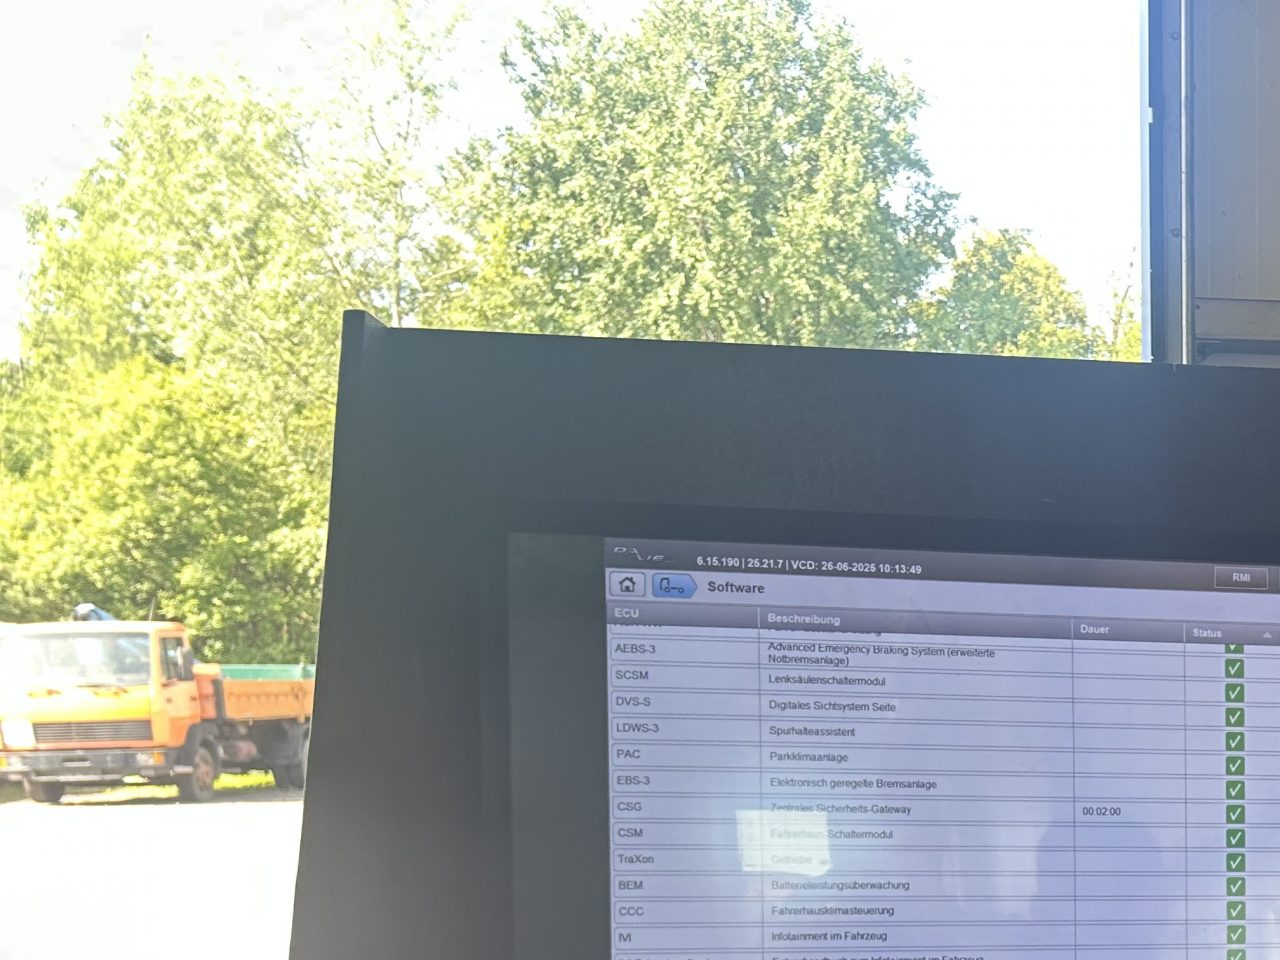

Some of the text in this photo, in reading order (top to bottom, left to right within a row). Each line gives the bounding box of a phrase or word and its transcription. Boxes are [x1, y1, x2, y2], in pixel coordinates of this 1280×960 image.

[697, 556, 740, 568] 6.15.190
[747, 558, 783, 569] 25.21.7
[791, 560, 818, 571] VCD:
[821, 561, 876, 573] 26-06-2025
[878, 563, 922, 575] 10:13:49
[1231, 572, 1251, 582] RMI
[707, 580, 765, 595] Software
[614, 608, 639, 618] ECU
[767, 613, 841, 627] Beschreibung
[1080, 624, 1109, 635] Dauer
[1192, 628, 1222, 639] Status
[614, 643, 656, 655] AEBS-3
[767, 642, 996, 659] Advanced Emergency Braking System (erweiterte
[768, 655, 850, 667] Notbremsanlage)
[615, 670, 649, 681] SCSM
[768, 674, 886, 687] Lenksäulenschaltermodul
[615, 696, 651, 707] DVS-S
[768, 700, 897, 713] Digitales Sichtsystem Seite
[616, 722, 660, 733] LDWS-3
[768, 726, 856, 738] Spurhalteassistent
[616, 749, 641, 760] PAC
[769, 752, 849, 764] Parkklimaanlage
[616, 775, 650, 786] EBS-3
[769, 777, 938, 791] Elektronisch geregelte Bremsanlage
[617, 801, 642, 812] CSG
[815, 803, 912, 816] Sicherheits-Gateway
[1082, 806, 1121, 816] 00:02:00
[617, 828, 644, 838] CSM
[617, 854, 655, 864] TraXon
[618, 880, 644, 890] BEM
[618, 906, 645, 917] CCC
[771, 930, 888, 943] Infotainment im Fahrzeug
